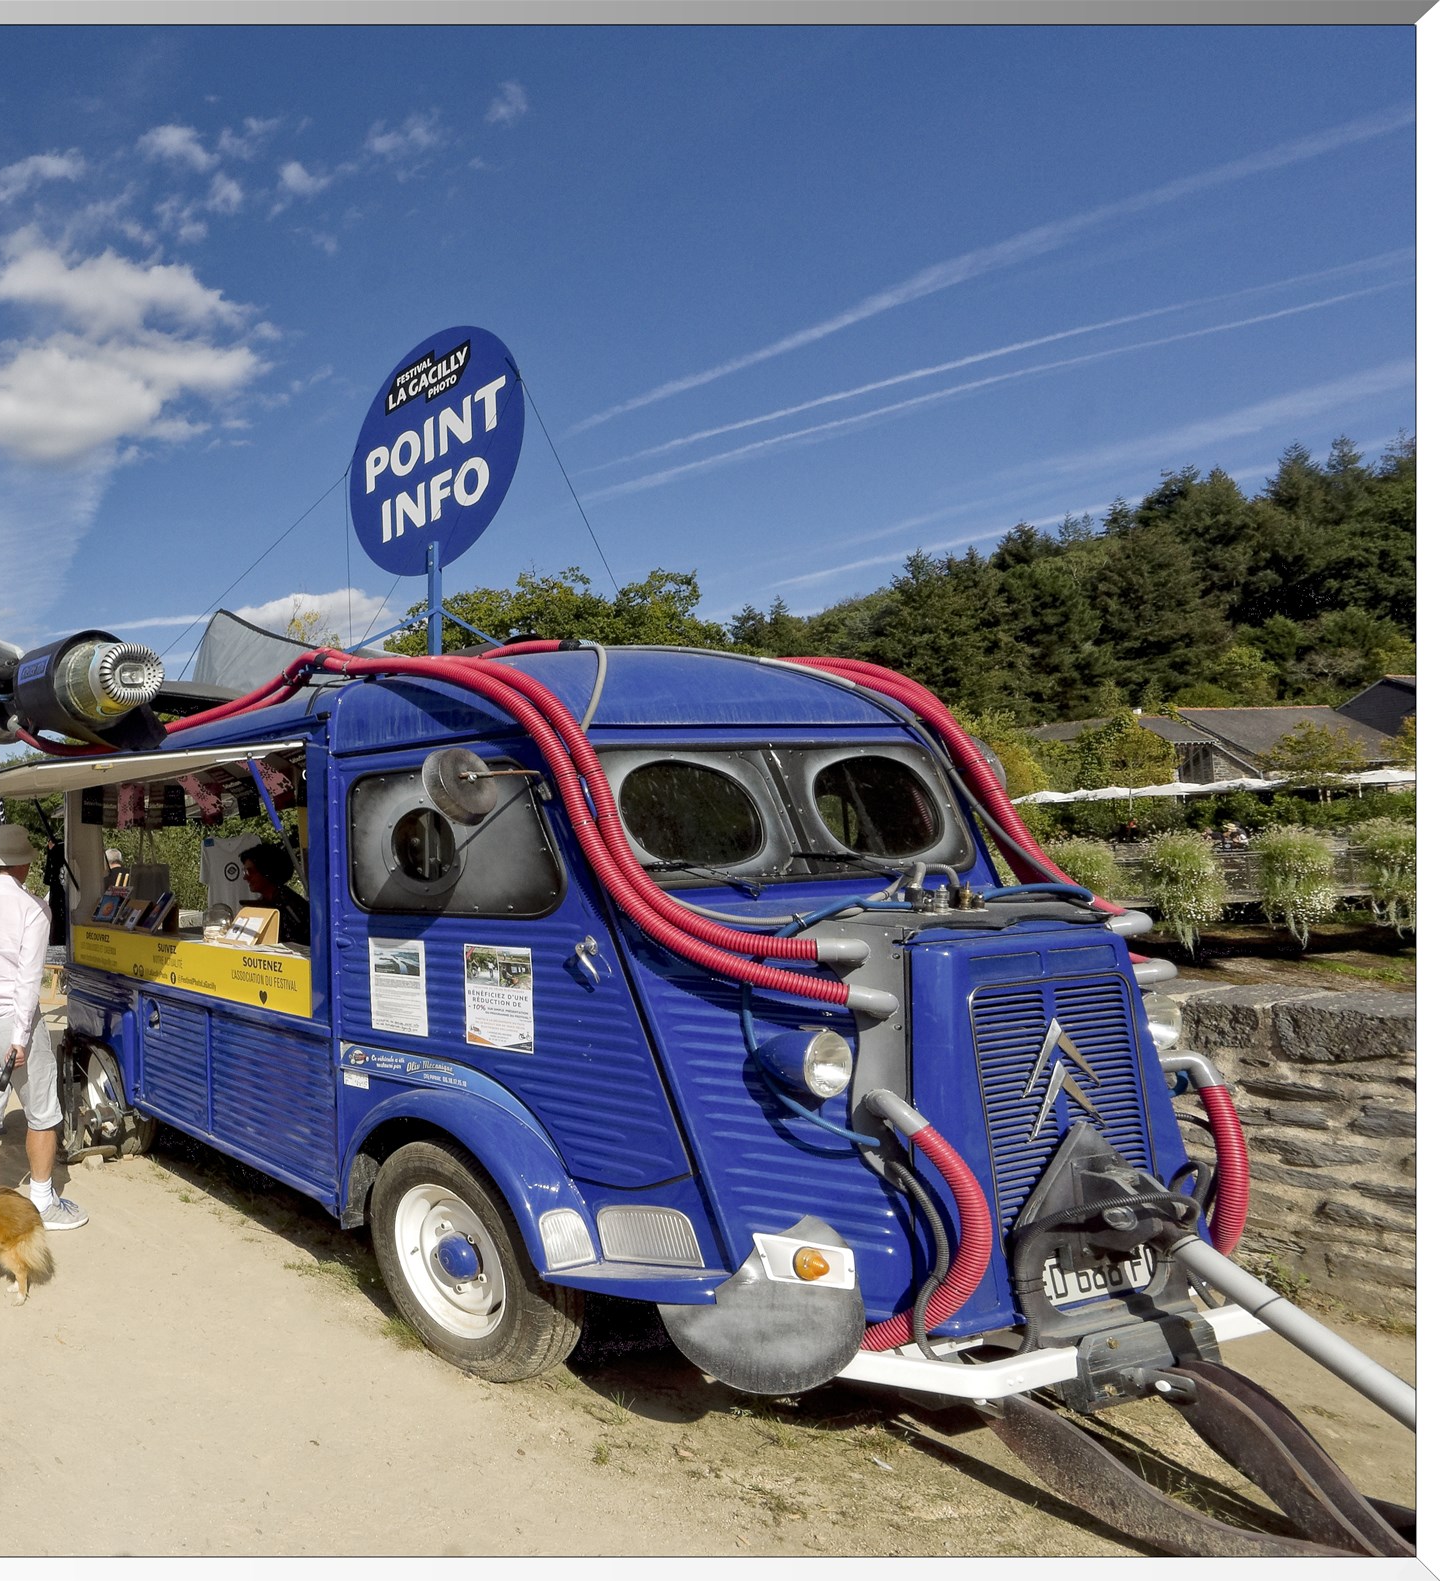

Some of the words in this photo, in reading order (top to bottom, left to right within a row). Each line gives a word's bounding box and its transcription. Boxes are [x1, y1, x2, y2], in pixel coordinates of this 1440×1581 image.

[388, 389, 406, 411] LA
[408, 346, 468, 398] GACILLY
[396, 358, 432, 387] FESTIVAL
[427, 374, 457, 399] PHOTO
[365, 375, 506, 495] POINT
[382, 456, 490, 543] INFO
[157, 942, 177, 954] SUIVEZ
[242, 956, 283, 973] SOUTENEZ
[265, 975, 273, 987] DU
[273, 976, 298, 992] FESTIVAL
[468, 989, 505, 999] BÉNÉFICIEZ
[508, 994, 529, 1002] D'UNE
[473, 996, 510, 1006] RÉDUCTION
